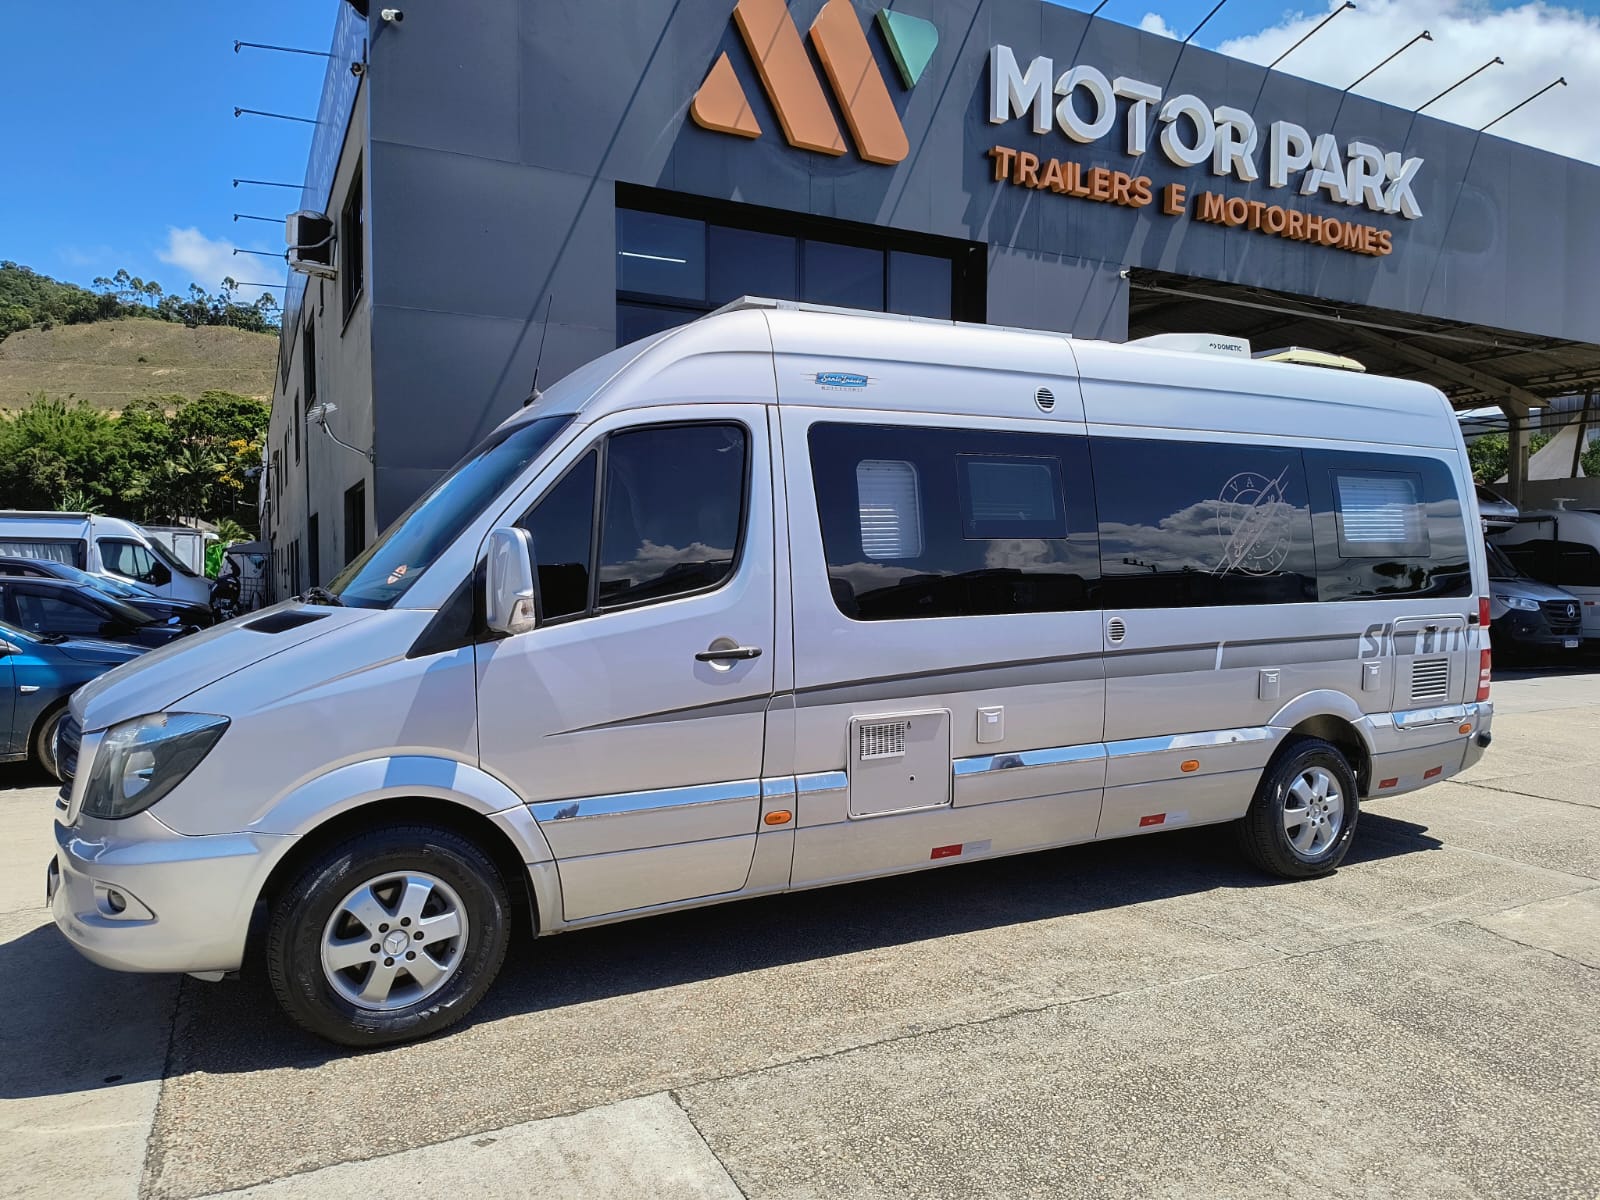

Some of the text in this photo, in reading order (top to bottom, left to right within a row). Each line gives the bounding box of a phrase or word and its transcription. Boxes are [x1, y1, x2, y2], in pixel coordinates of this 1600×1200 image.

[989, 146, 1393, 256] TRAILERS E MOTORHOMES
[990, 44, 1425, 219] MOTOR PARK
